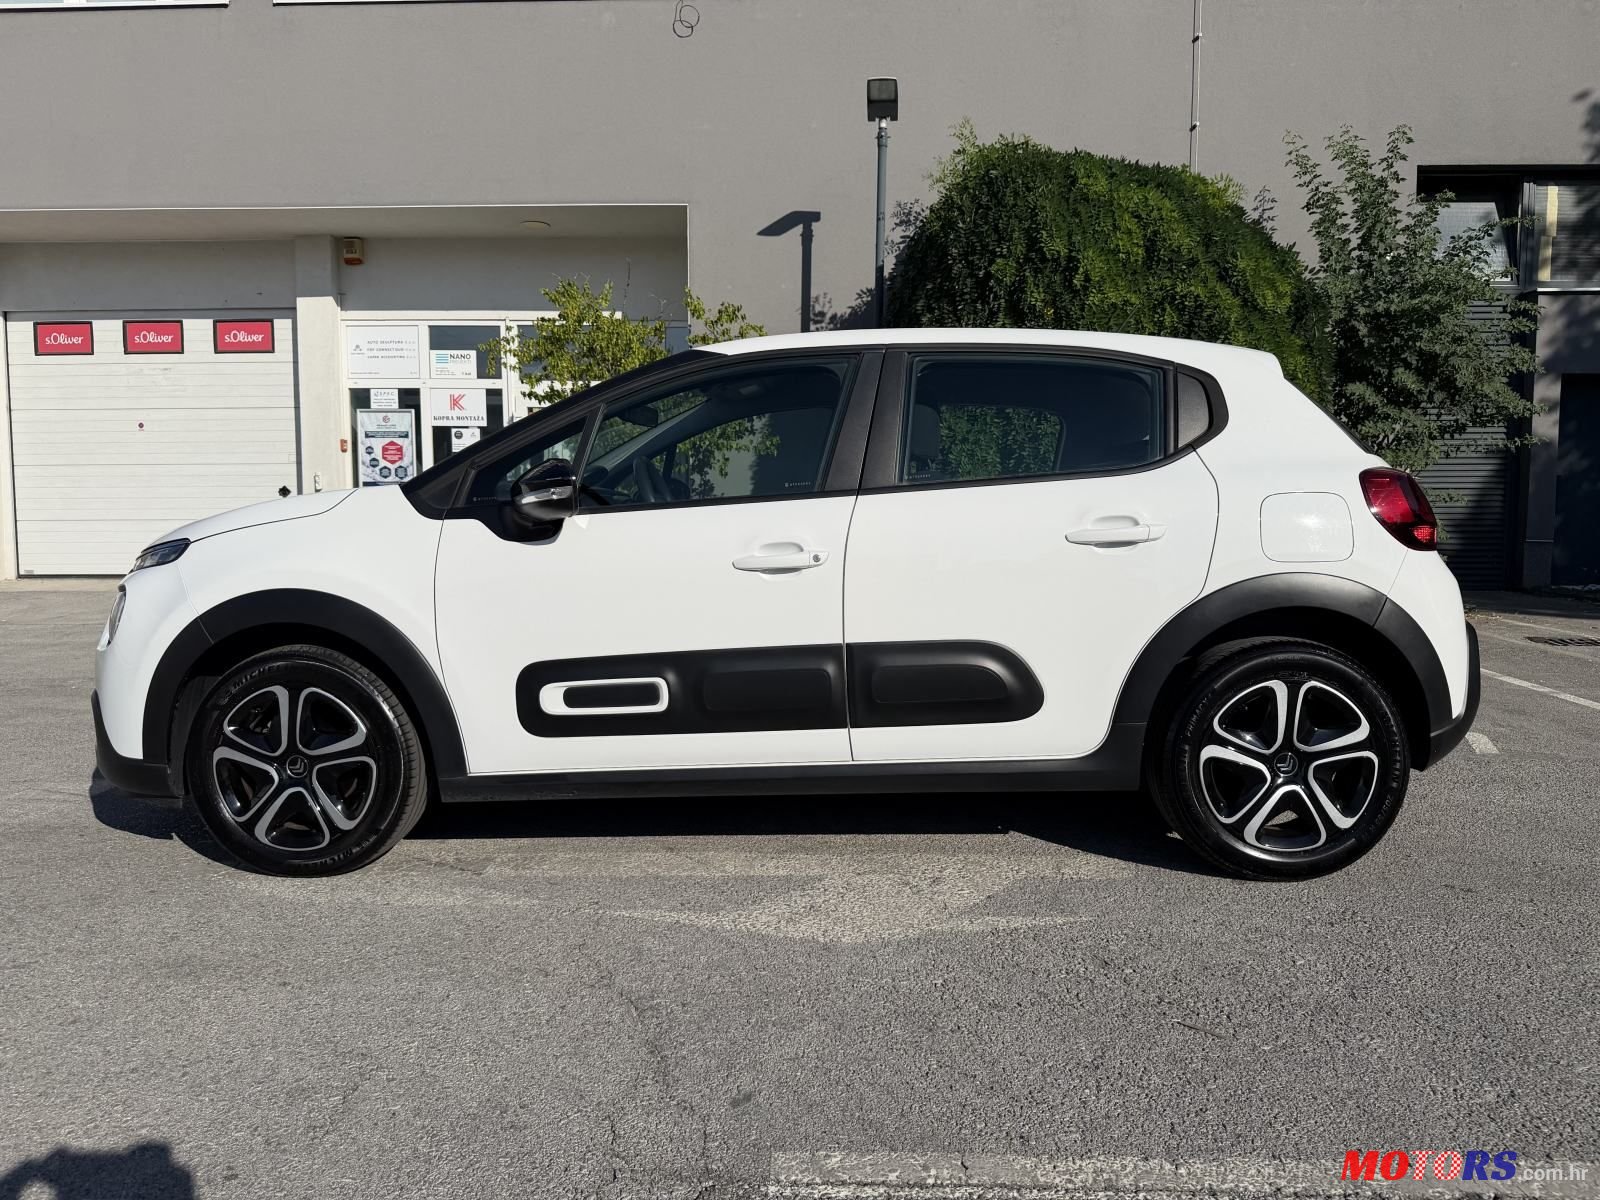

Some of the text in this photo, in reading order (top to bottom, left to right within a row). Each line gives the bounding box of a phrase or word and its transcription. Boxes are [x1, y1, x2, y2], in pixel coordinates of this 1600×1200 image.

[45, 333, 84, 345] s.Oliver
[134, 330, 174, 343] s.Oliver
[224, 329, 265, 343] s.Oliver
